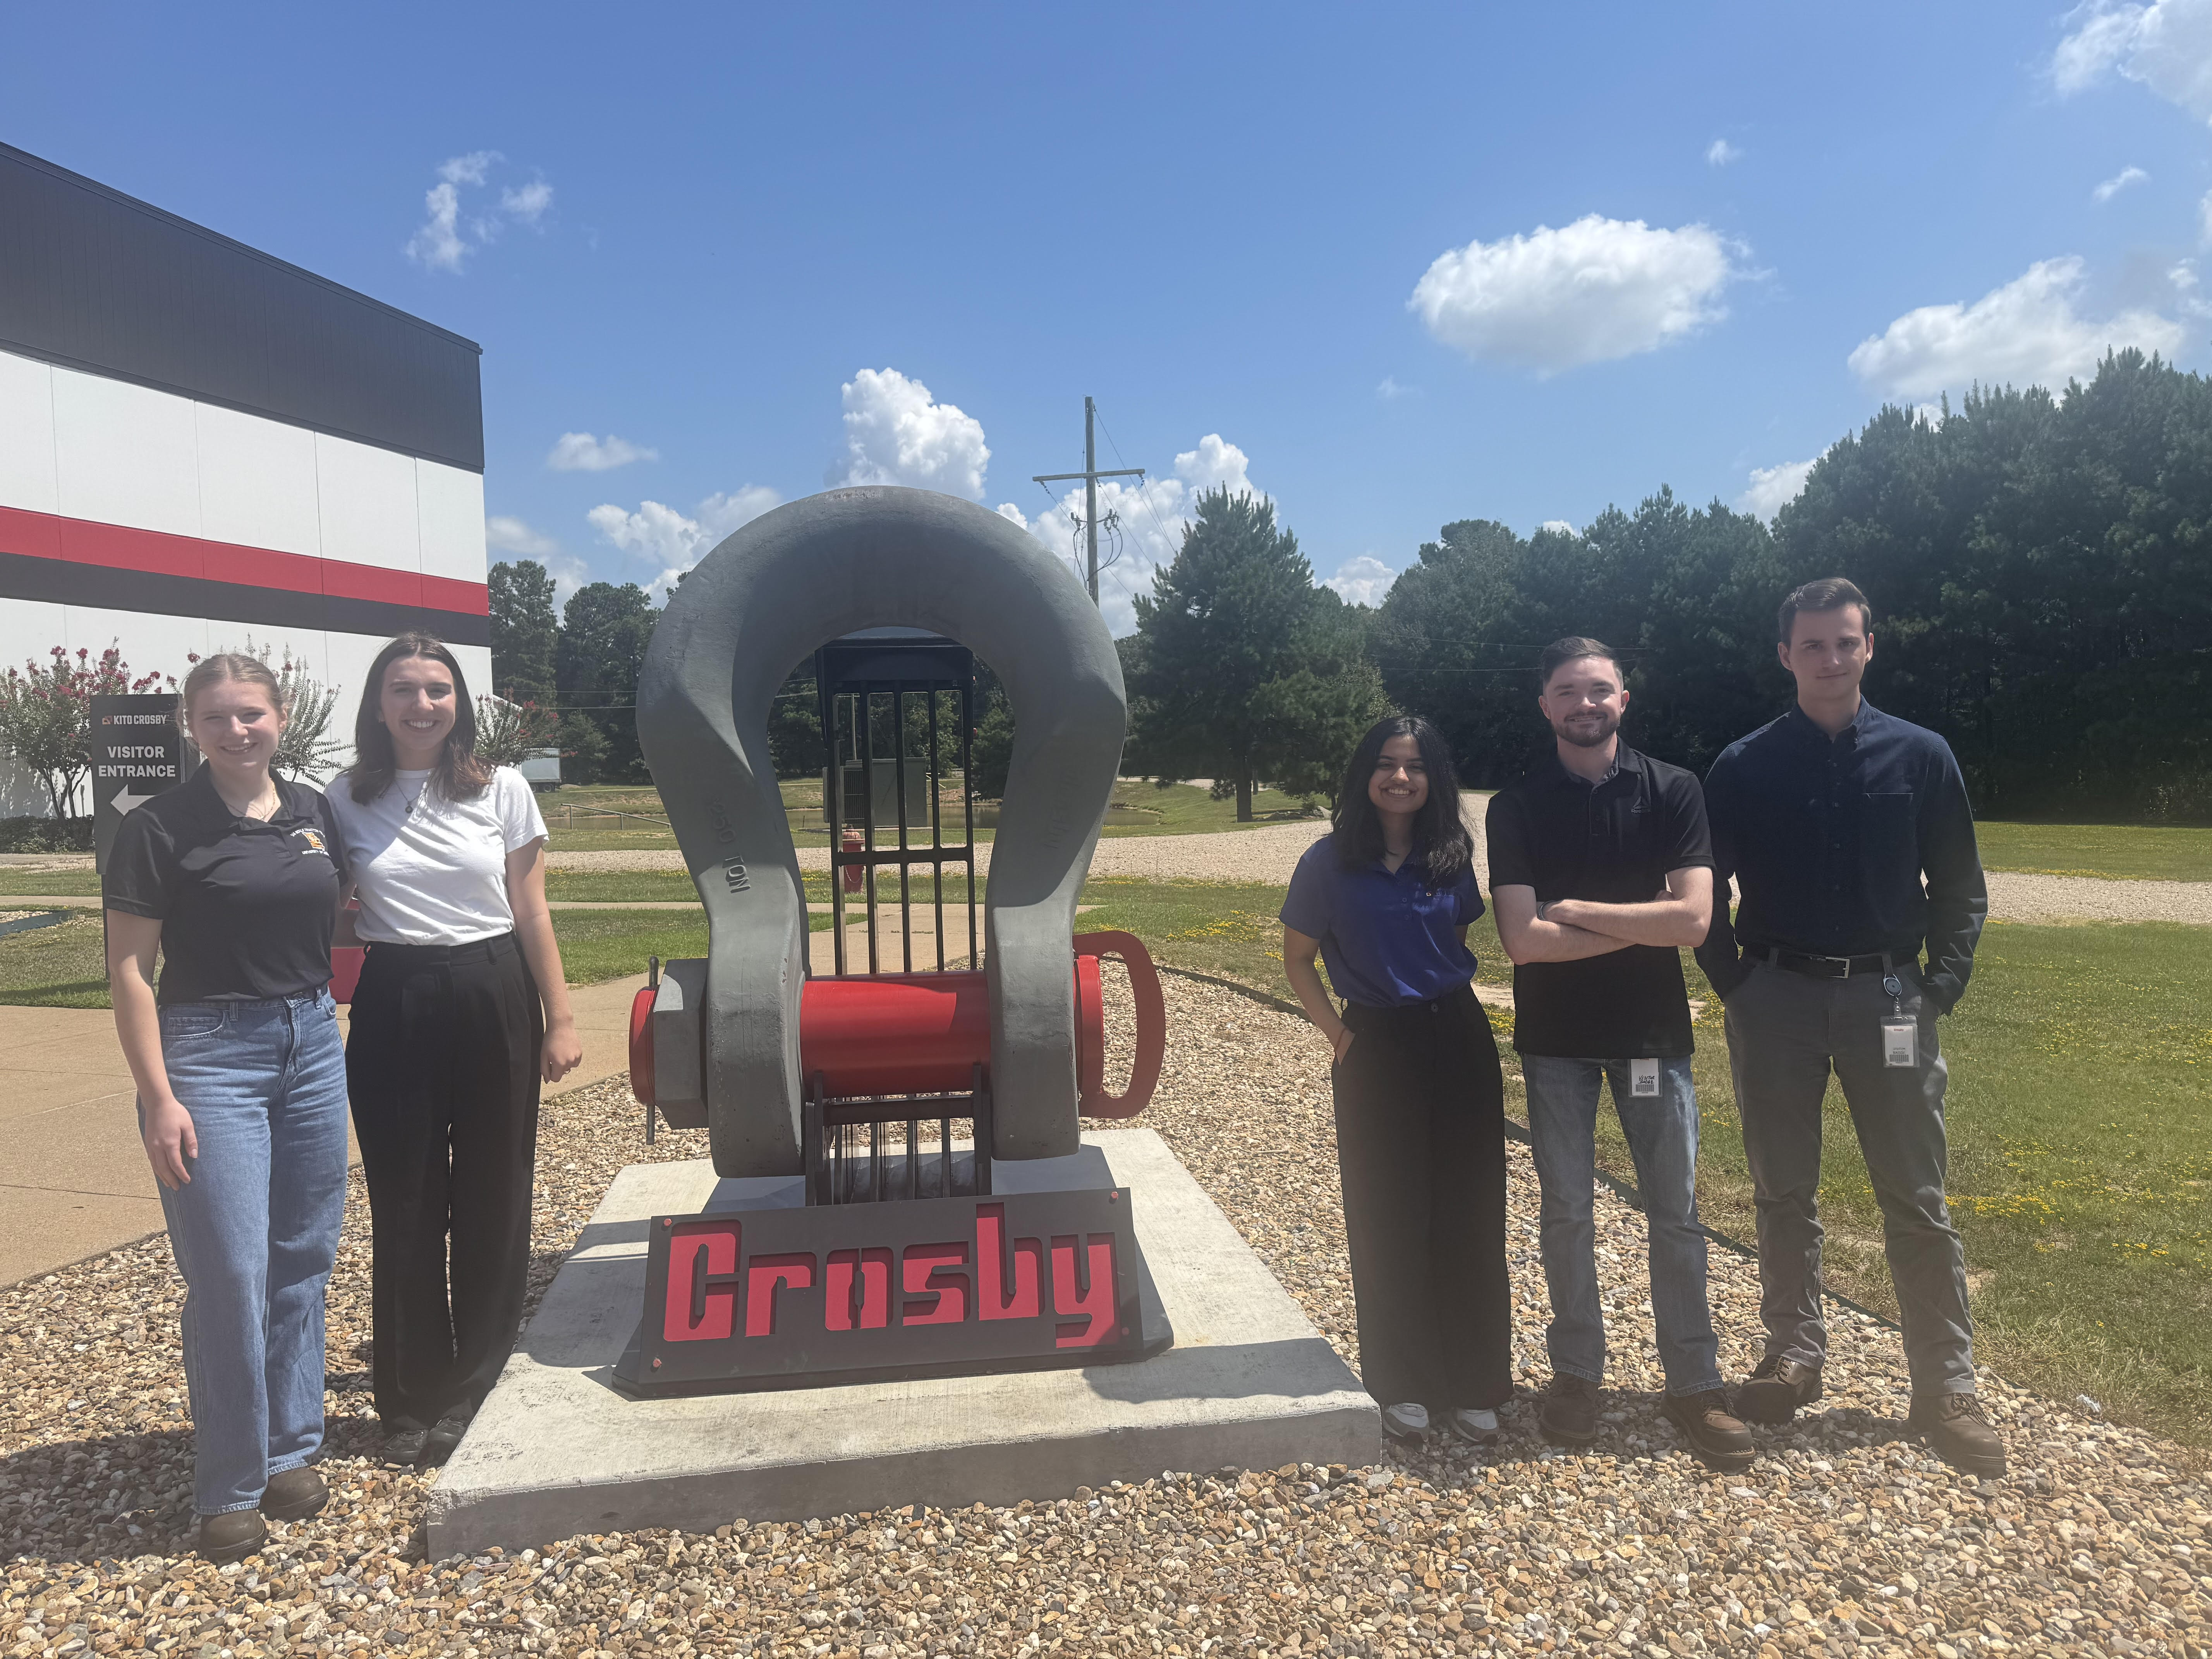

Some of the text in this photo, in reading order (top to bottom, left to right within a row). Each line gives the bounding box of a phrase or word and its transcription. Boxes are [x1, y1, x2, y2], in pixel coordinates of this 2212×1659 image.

[114, 715, 167, 725] KITO CROSBY
[107, 746, 164, 758] VISITOR
[98, 765, 175, 777] ENTRANCE
[724, 853, 751, 894] TON
[663, 1202, 1120, 1348] Crosby
